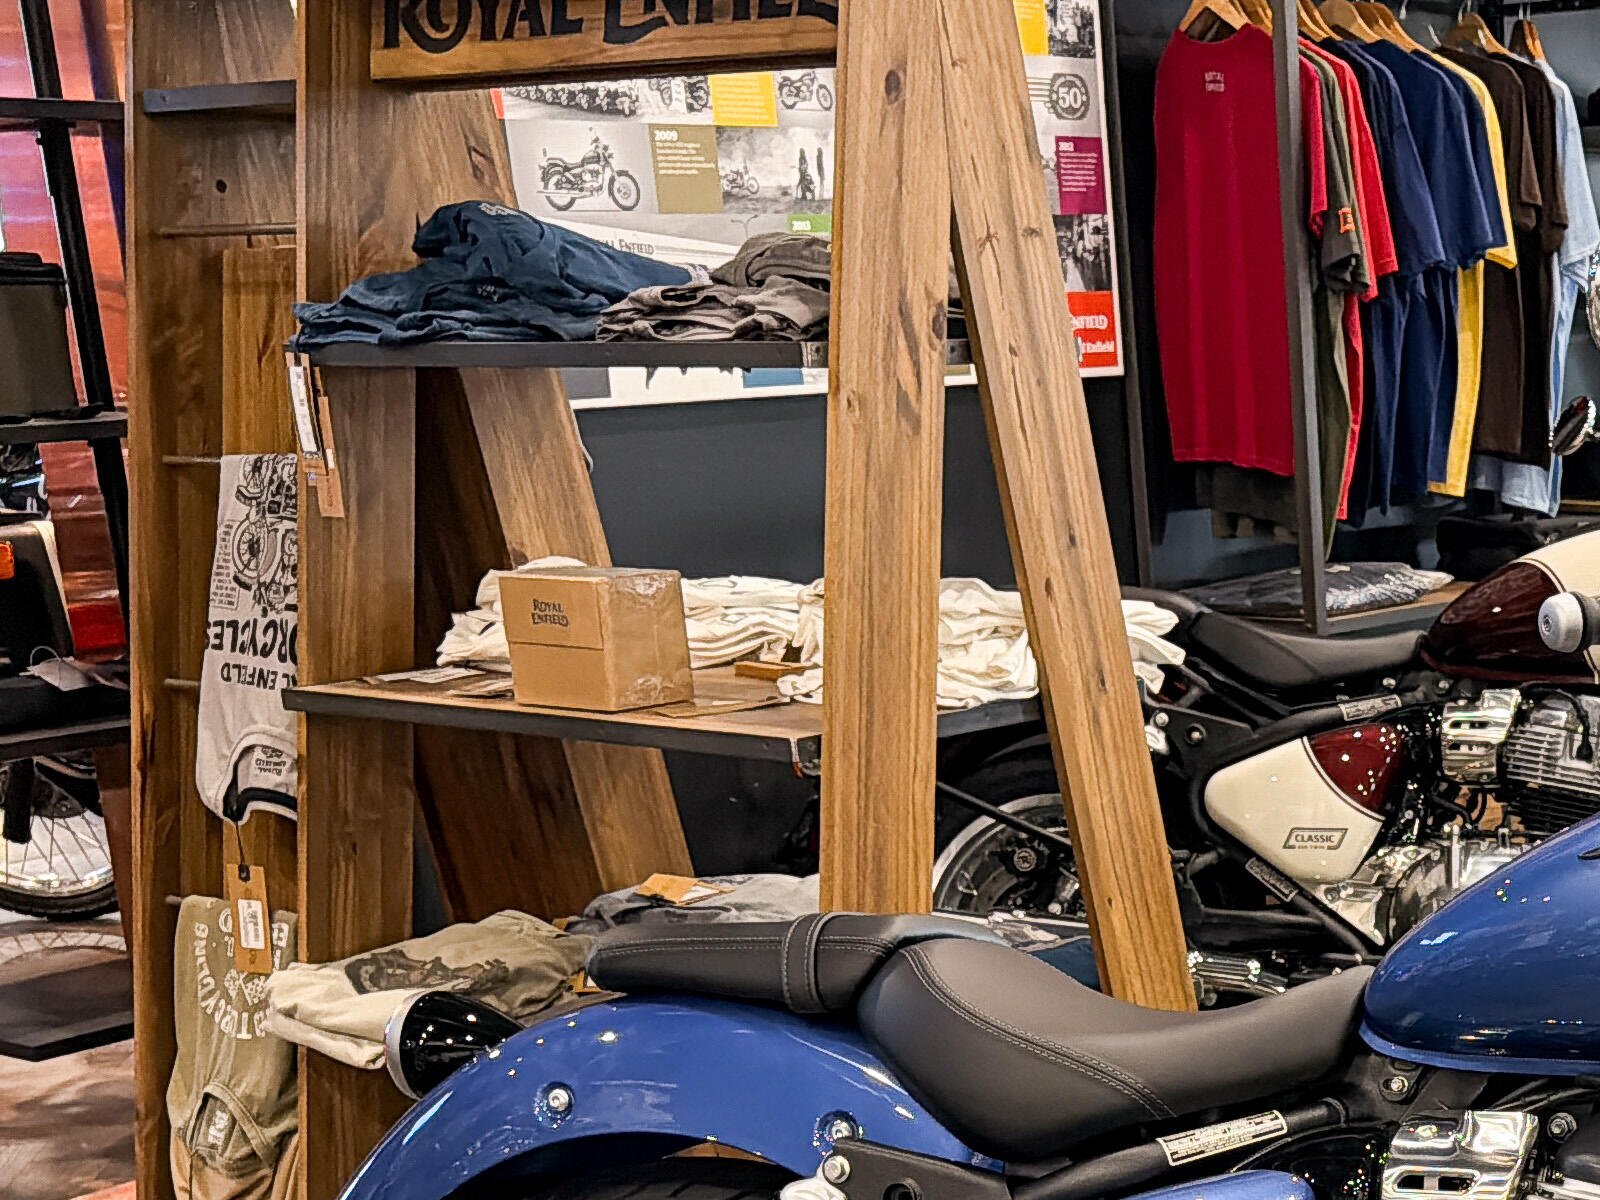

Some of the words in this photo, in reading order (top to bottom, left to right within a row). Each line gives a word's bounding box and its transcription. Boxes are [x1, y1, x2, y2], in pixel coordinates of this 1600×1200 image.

[1058, 88, 1082, 109] 50
[532, 598, 564, 613] ROYAL
[1294, 833, 1336, 843] CLASSIC
